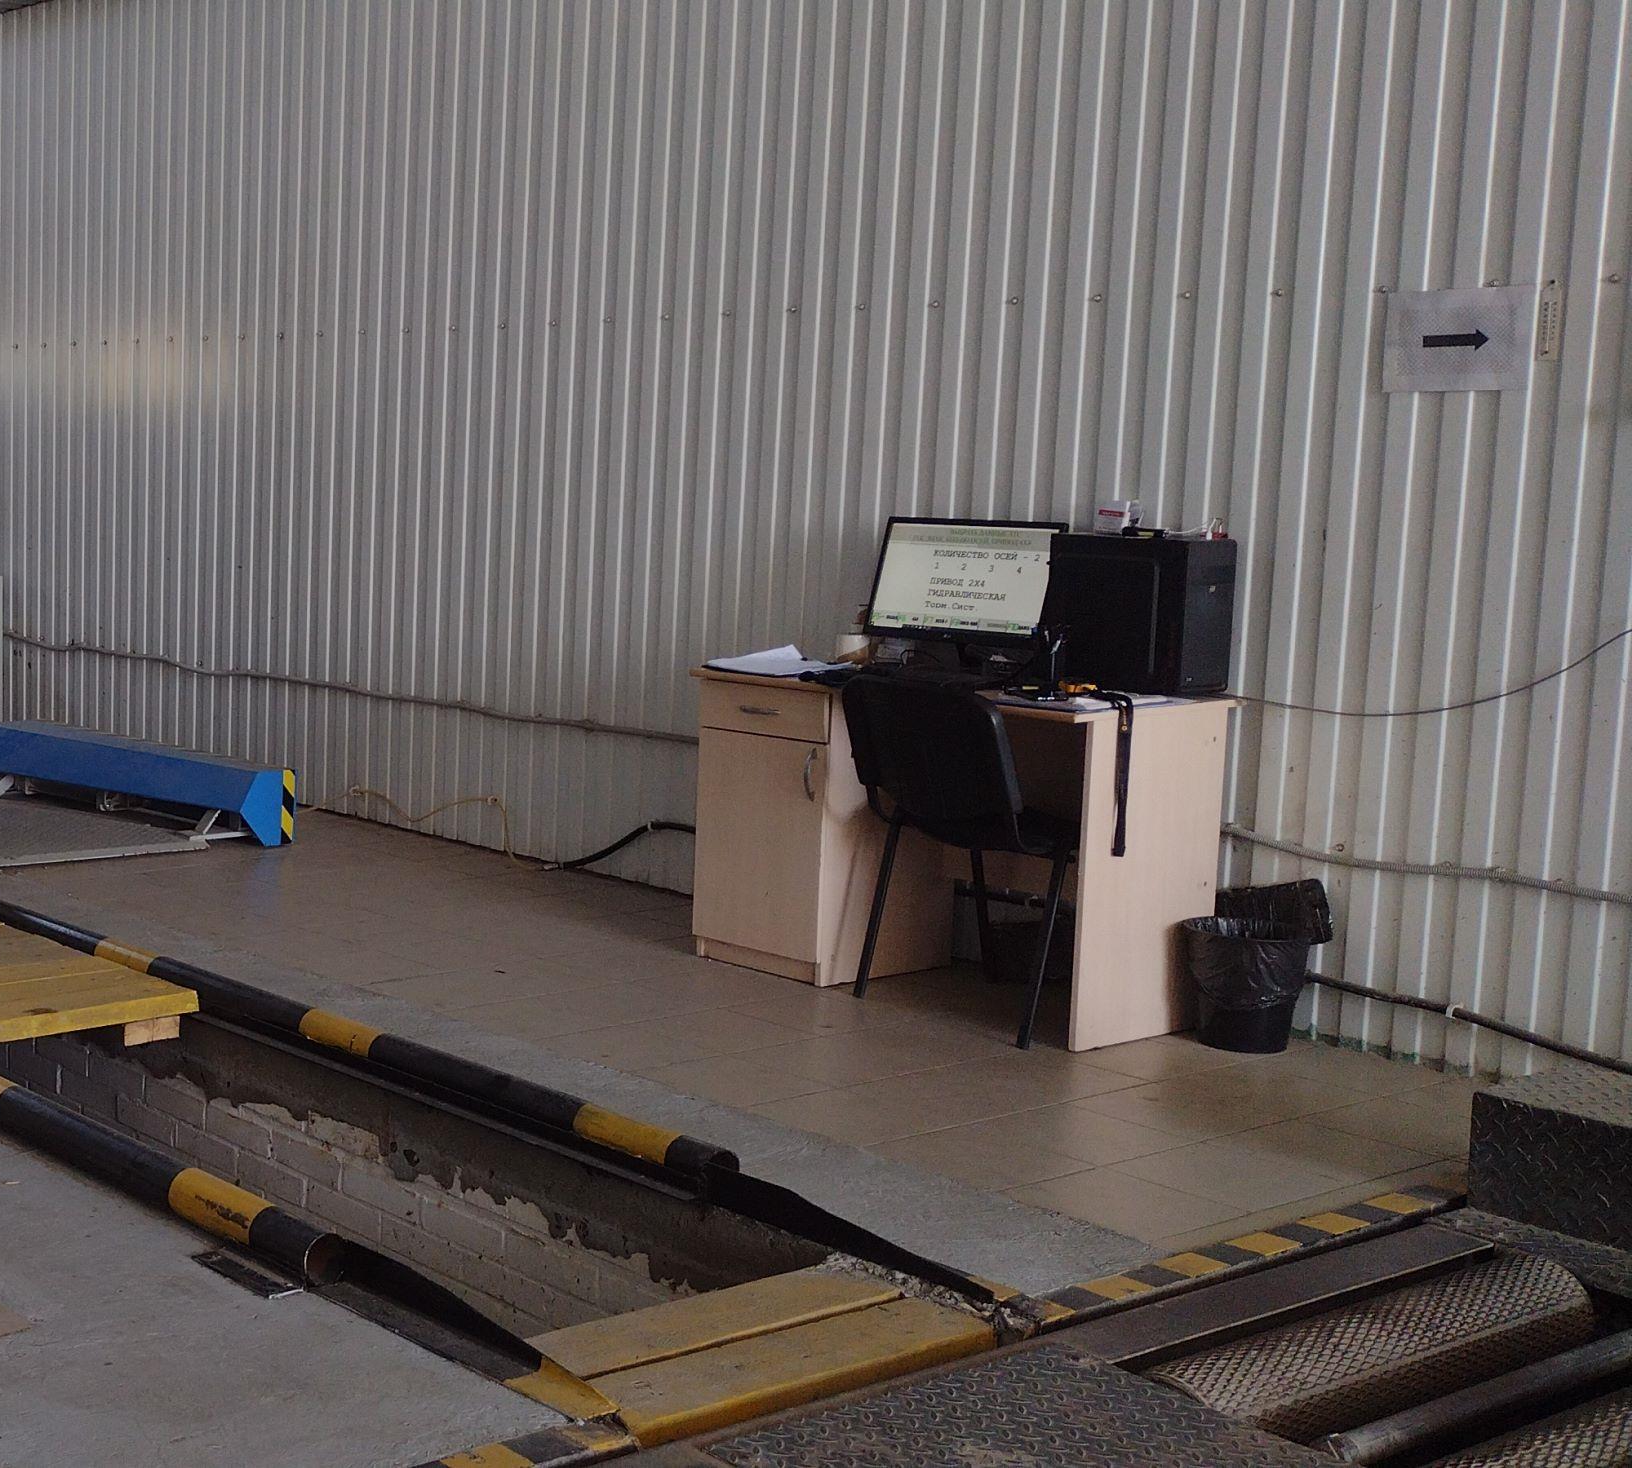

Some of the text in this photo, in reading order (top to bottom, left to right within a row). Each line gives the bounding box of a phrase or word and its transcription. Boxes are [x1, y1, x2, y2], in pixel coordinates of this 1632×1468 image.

[933, 549, 989, 559] КОЛИЧЕСТВО
[994, 550, 1018, 561] ОСЕЙ
[1034, 554, 1041, 562] 2
[929, 576, 965, 587] ПРИВОД
[927, 588, 1007, 601] ГИДРАВЛИЧЕСКАЯ
